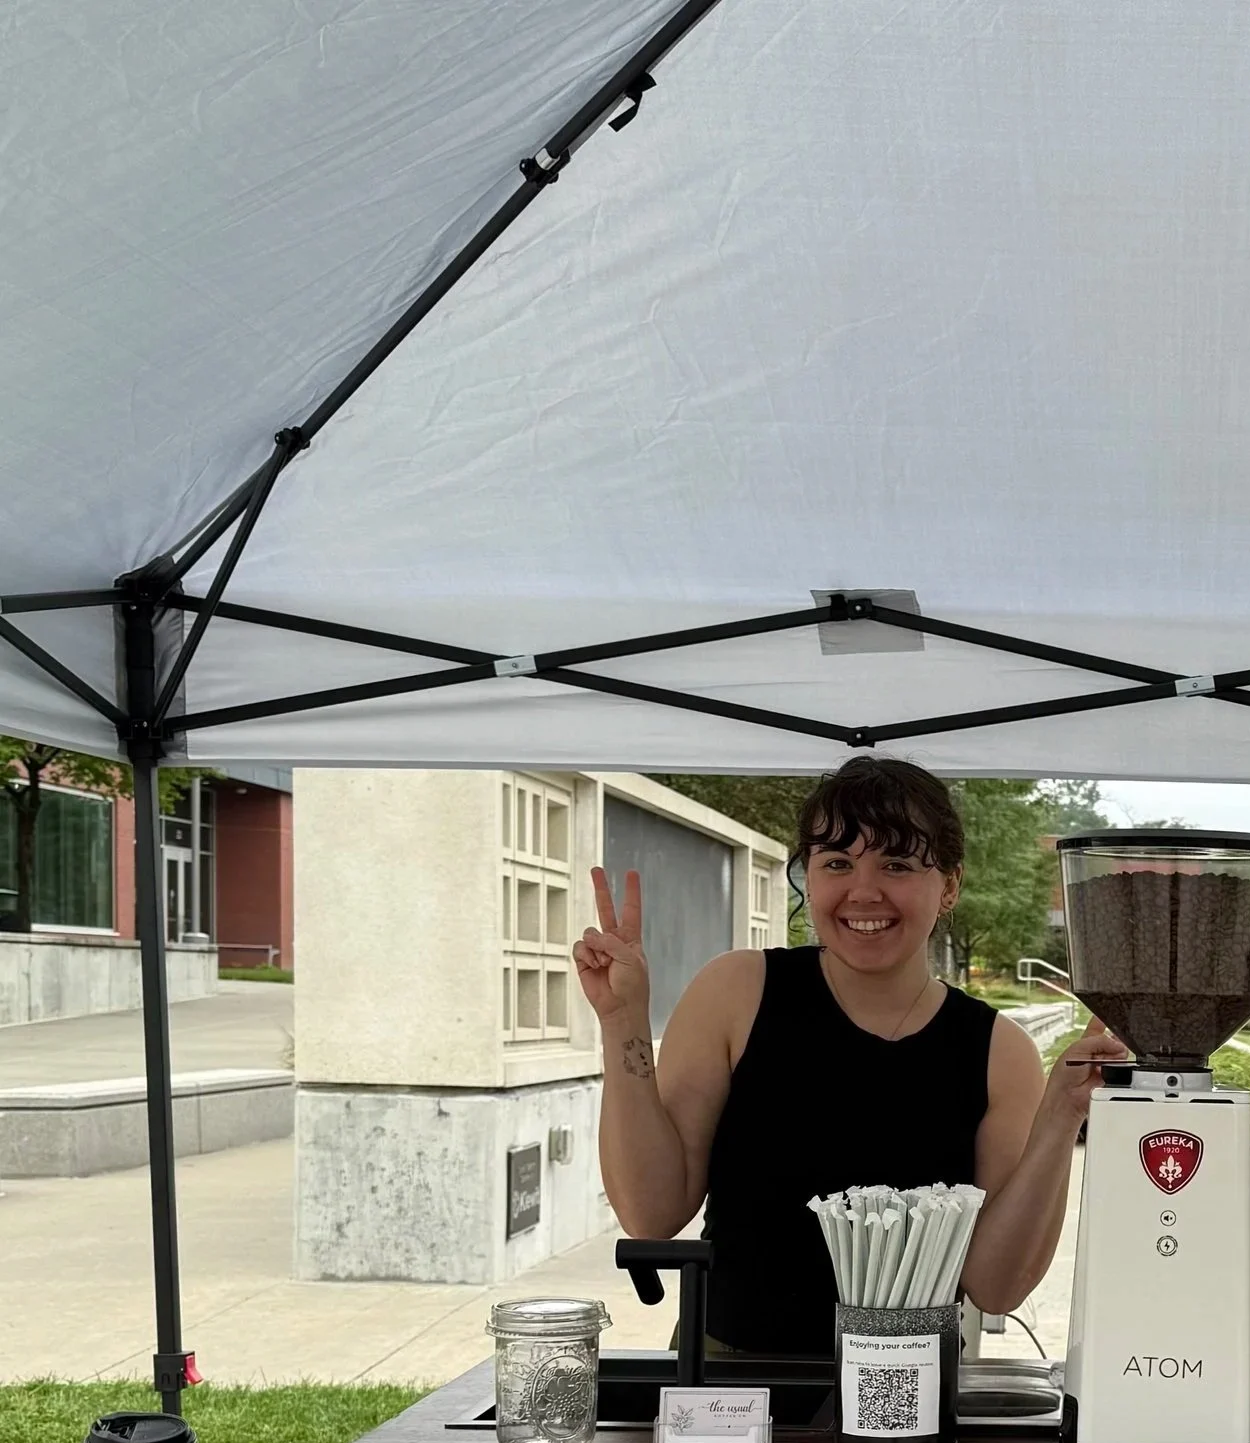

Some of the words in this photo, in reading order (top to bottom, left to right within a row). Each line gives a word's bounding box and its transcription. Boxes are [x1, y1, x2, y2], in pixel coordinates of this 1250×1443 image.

[1149, 1136, 1194, 1150] EUREKA
[849, 1340, 880, 1350] Enjoying
[881, 1342, 900, 1350] your
[902, 1341, 931, 1349] coffee?
[1123, 1356, 1203, 1379] ATOM
[698, 1399, 726, 1413] the
[727, 1399, 762, 1414] usual
